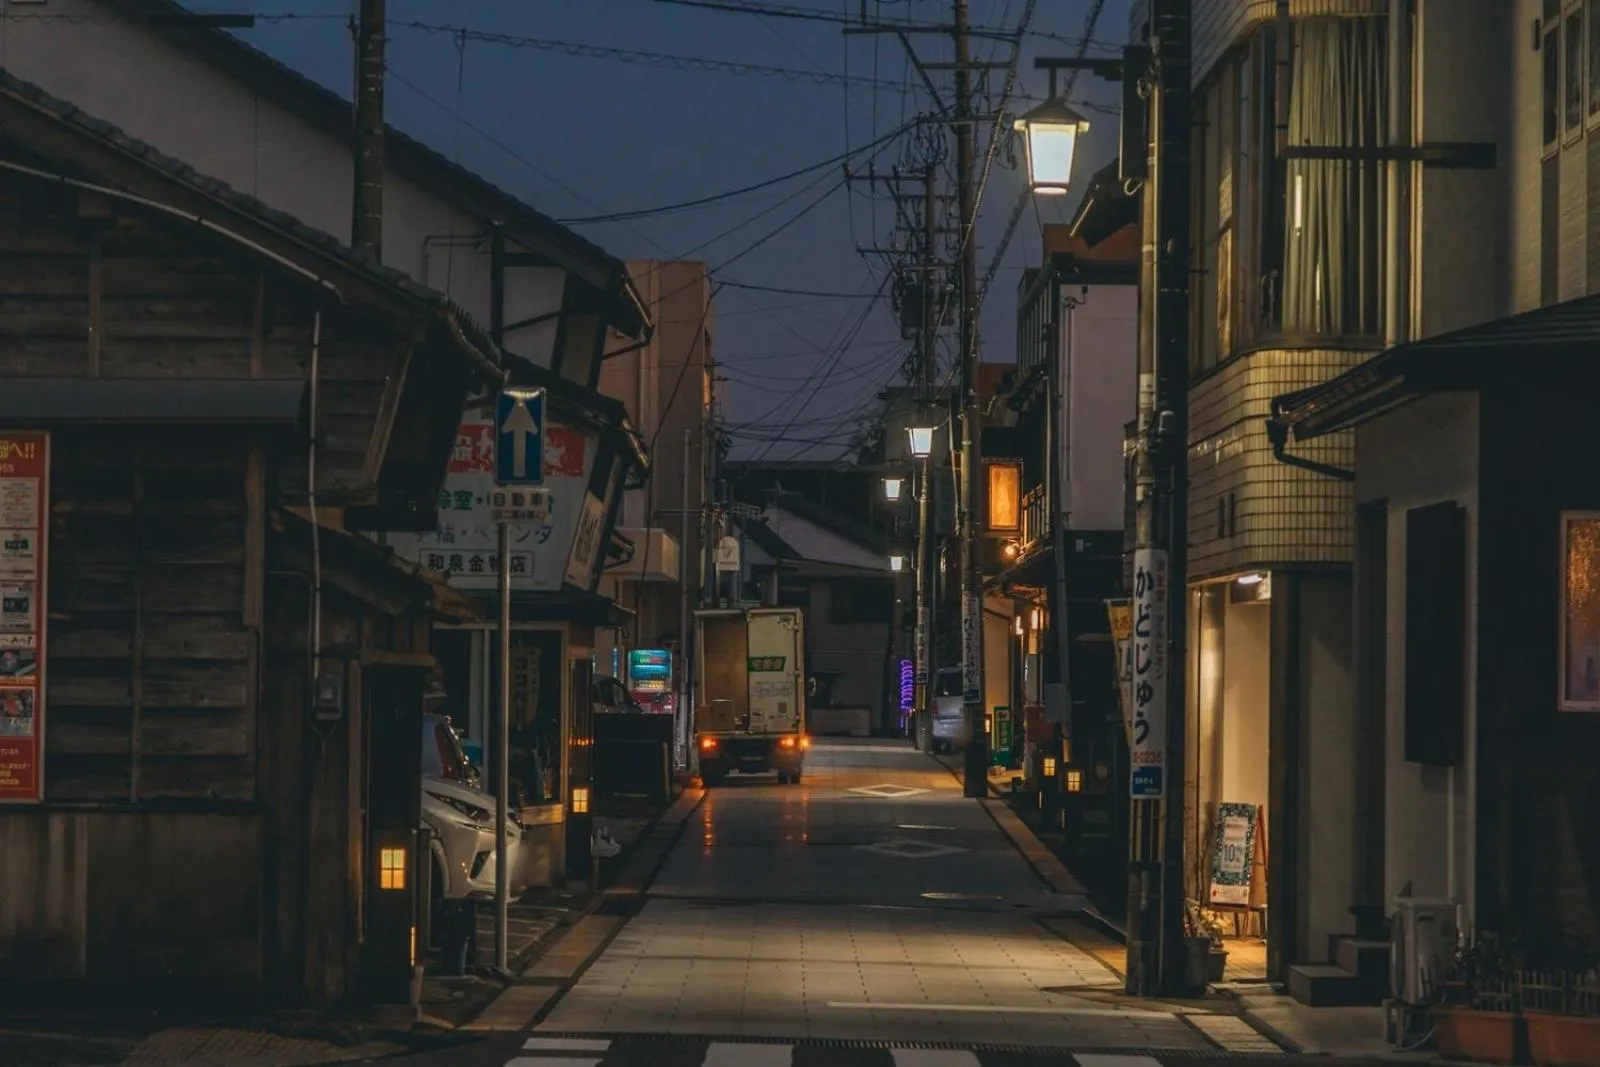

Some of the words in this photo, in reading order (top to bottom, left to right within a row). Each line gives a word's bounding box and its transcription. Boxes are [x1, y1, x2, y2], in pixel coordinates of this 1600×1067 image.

[494, 492, 542, 506] 自動車
[427, 553, 527, 572] 和泉金物店
[1134, 565, 1154, 745] かどじゅう
